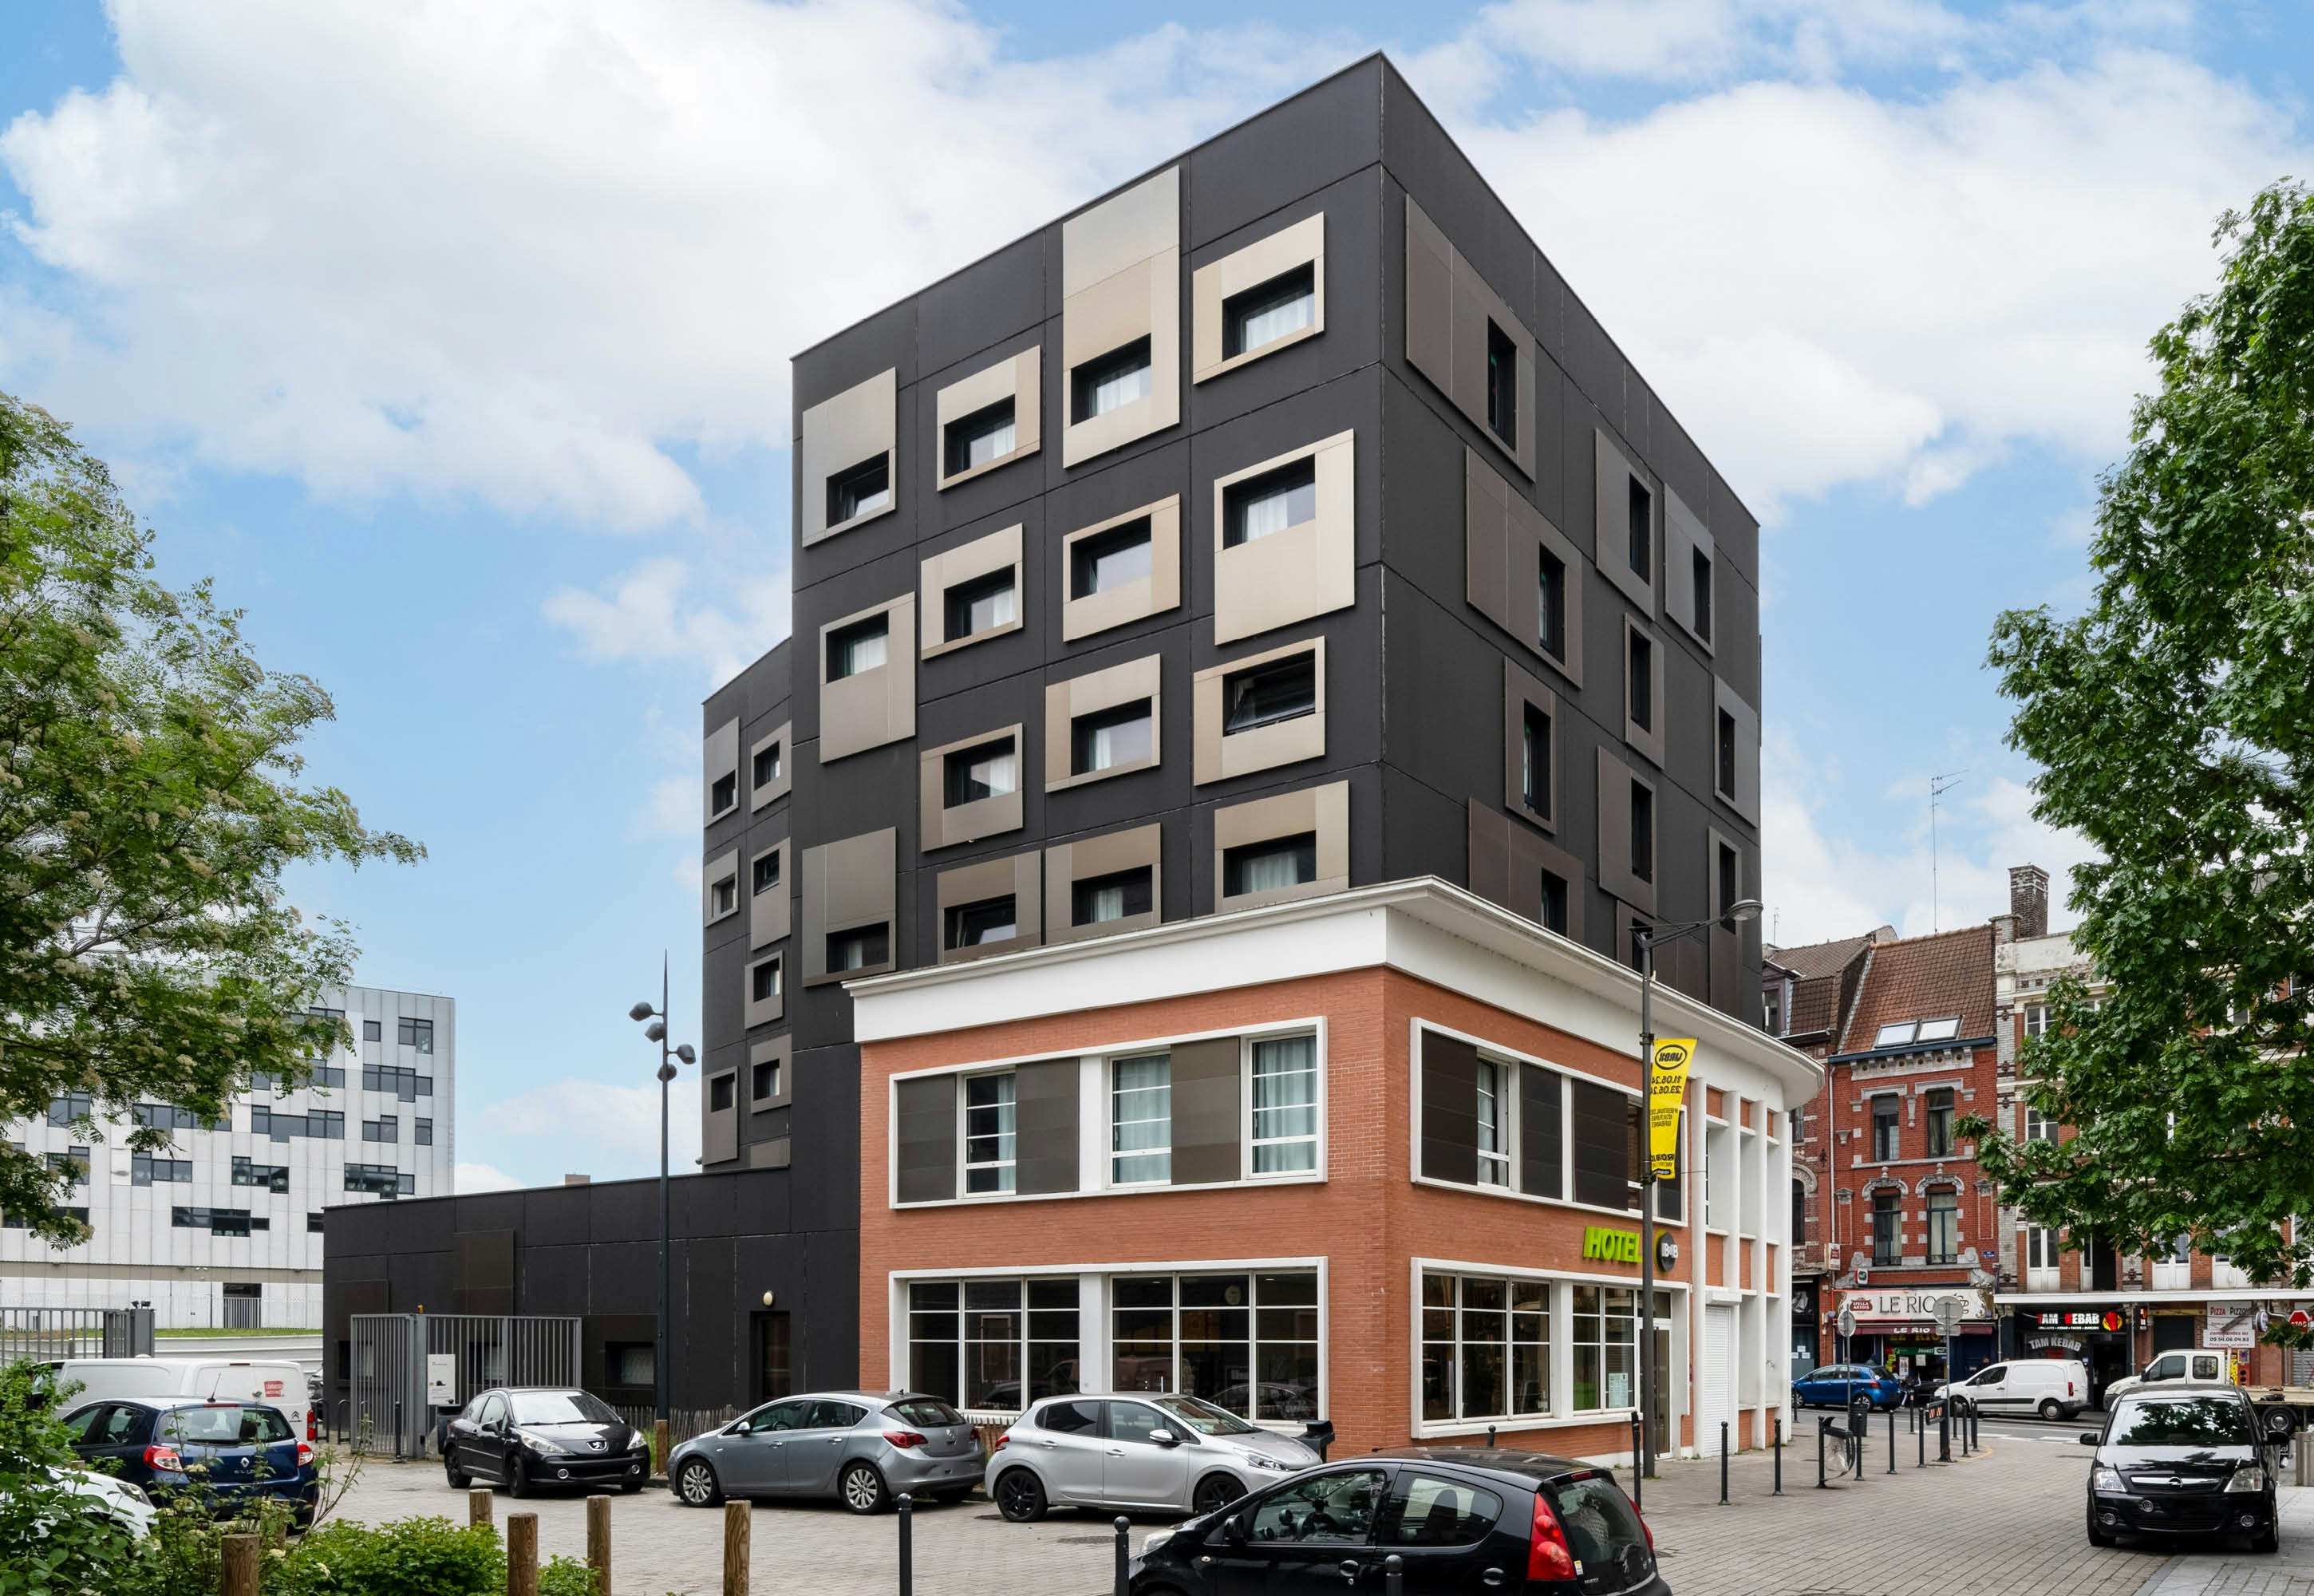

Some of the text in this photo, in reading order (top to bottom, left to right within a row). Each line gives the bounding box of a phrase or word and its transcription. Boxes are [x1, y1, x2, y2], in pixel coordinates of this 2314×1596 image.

[1583, 1226, 1643, 1263] HOTEL
[1879, 1295, 1937, 1314] LE RIO
[2209, 1307, 2226, 1316] PIZZA
[2036, 1313, 2100, 1325] TAM KEBAB
[2028, 1337, 2082, 1352] TAM KEBAB
